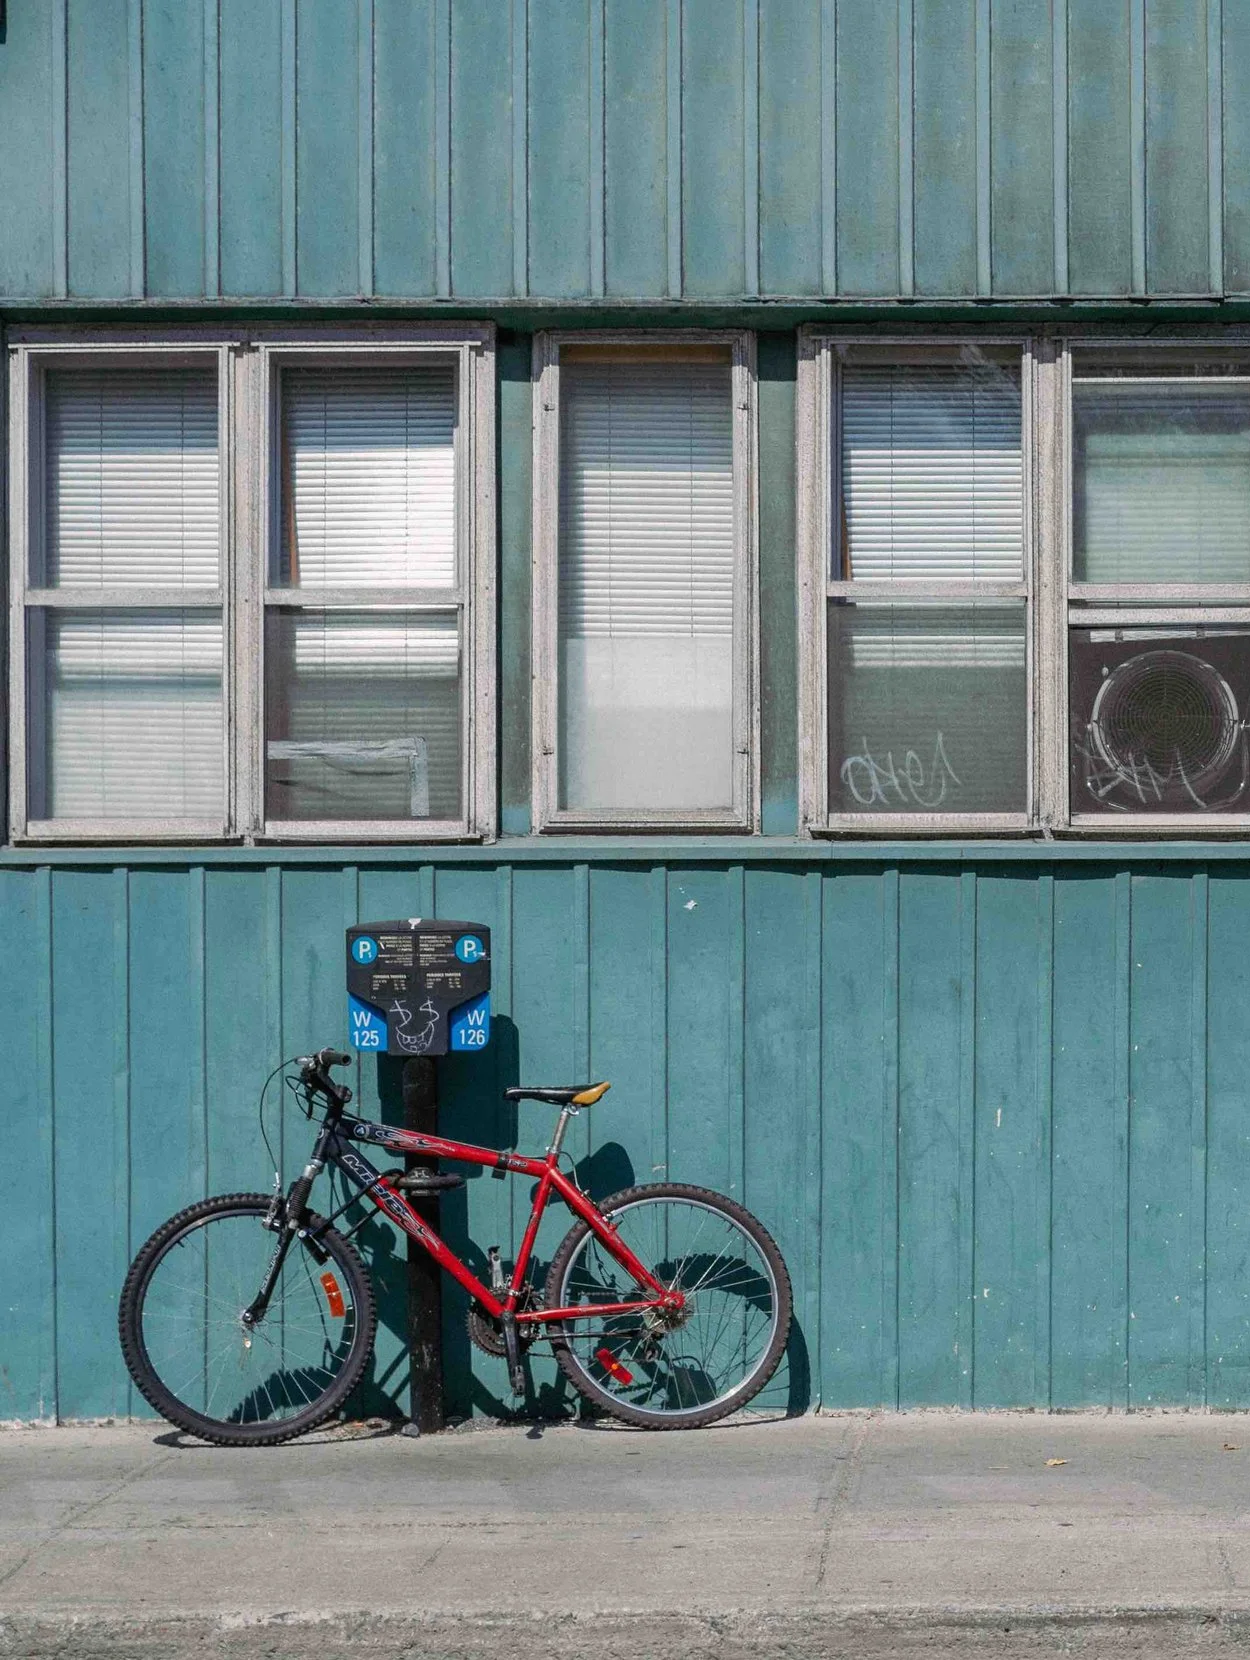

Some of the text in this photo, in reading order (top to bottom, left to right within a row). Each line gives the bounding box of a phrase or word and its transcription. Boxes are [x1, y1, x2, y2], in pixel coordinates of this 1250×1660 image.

[353, 1011, 372, 1028] W
[467, 1009, 486, 1026] W
[353, 1030, 380, 1047] 125
[459, 1029, 486, 1046] 126
